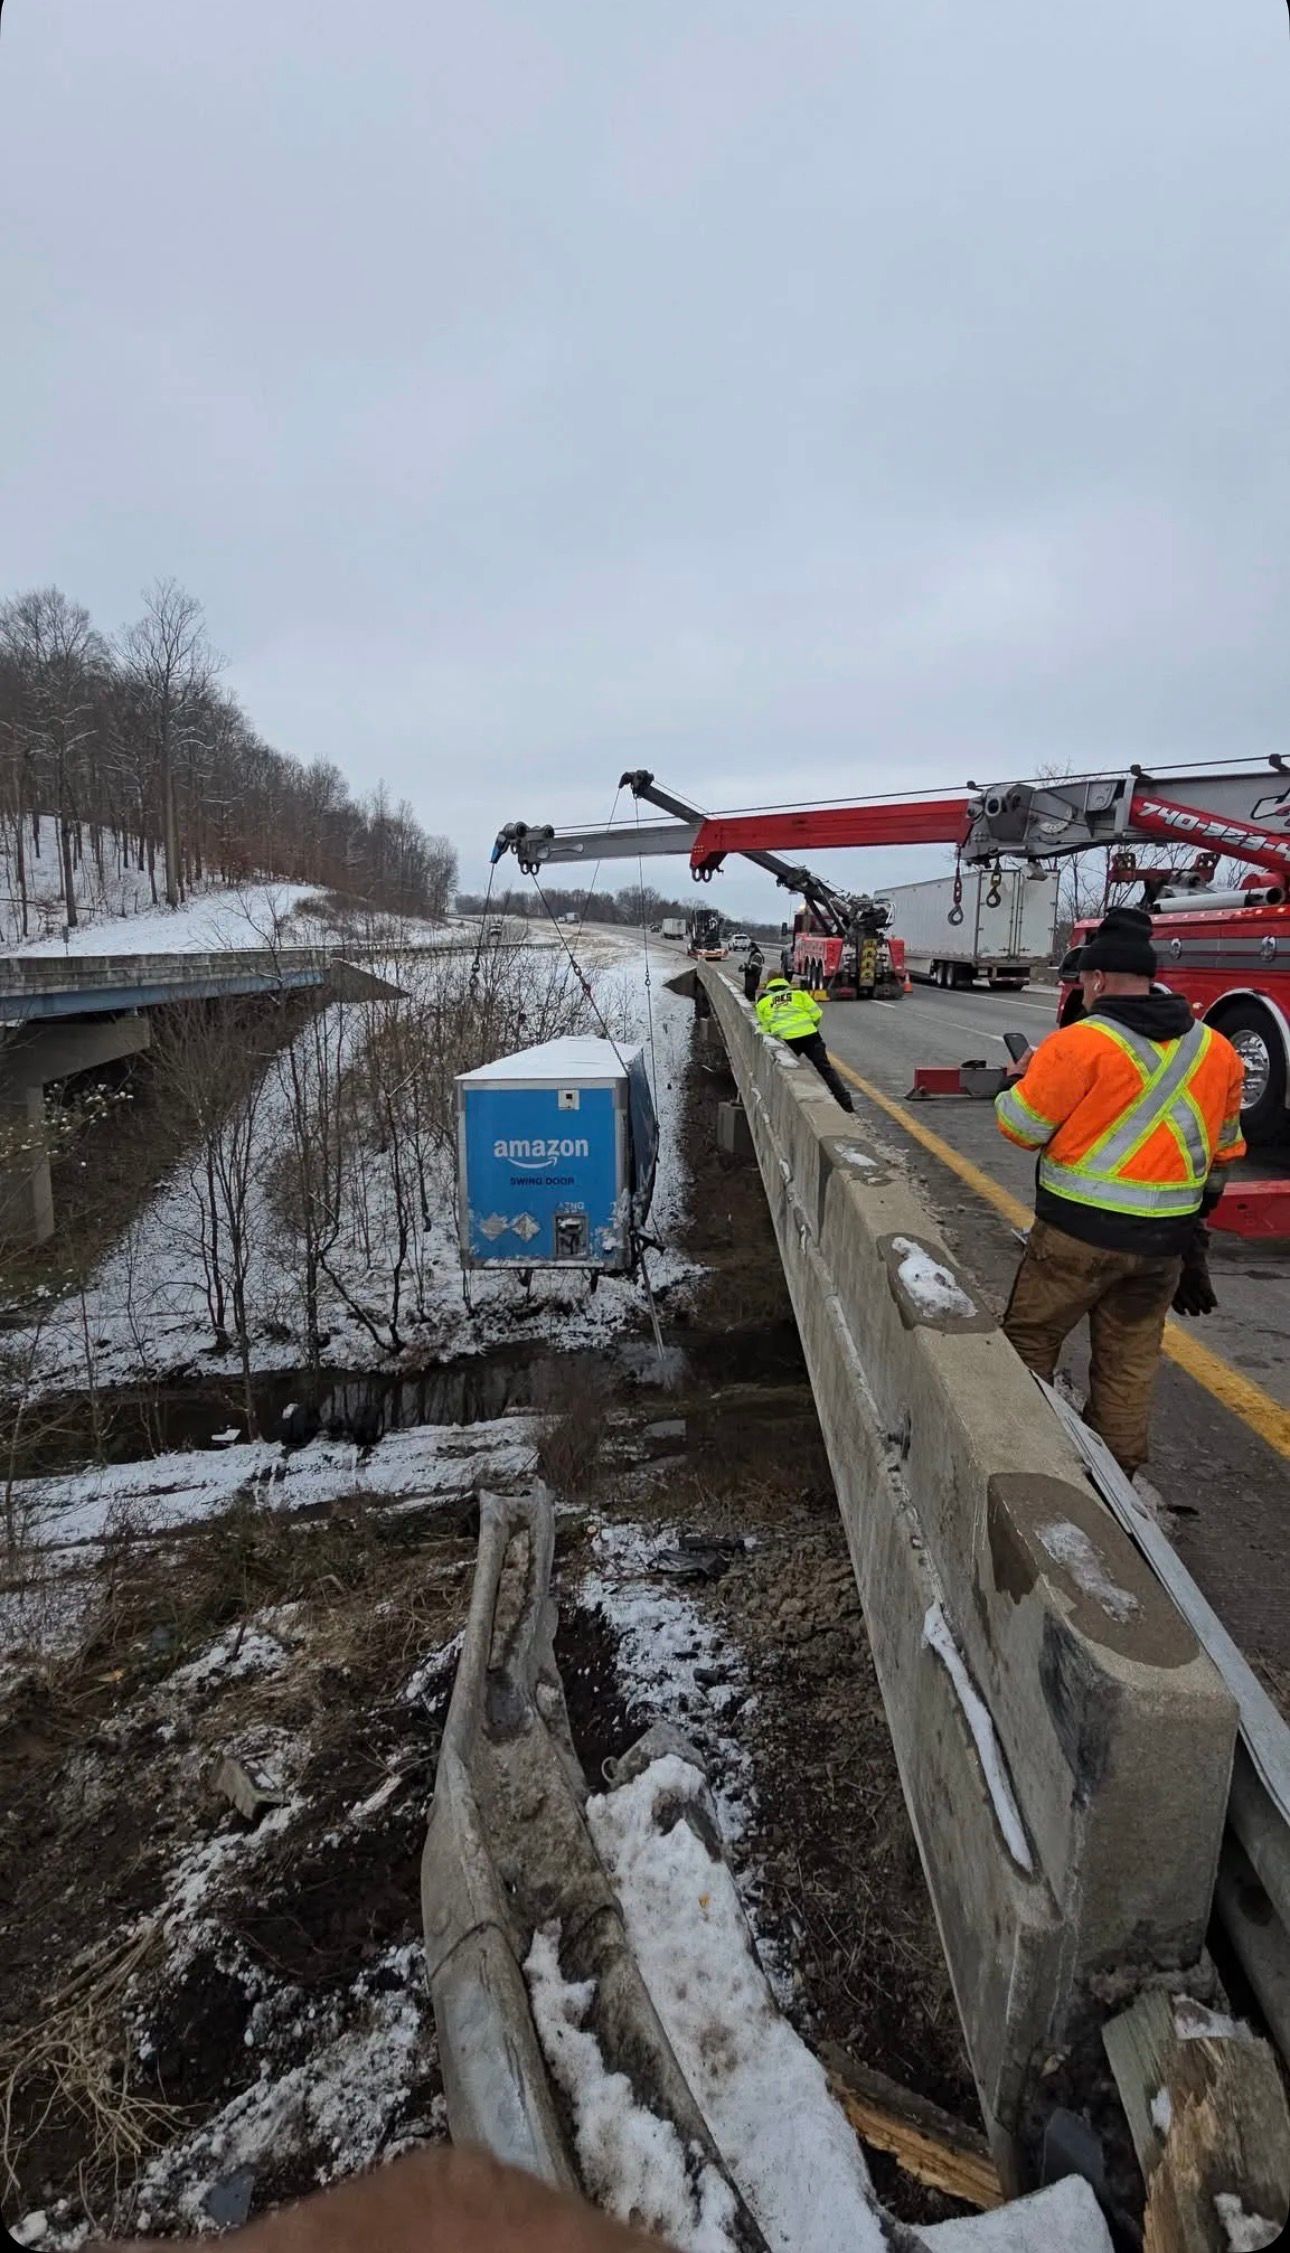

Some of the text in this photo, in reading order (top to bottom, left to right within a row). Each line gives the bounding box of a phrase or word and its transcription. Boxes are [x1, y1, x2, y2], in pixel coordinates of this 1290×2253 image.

[494, 1139, 589, 1157] amazon
[510, 1177, 575, 1185] SWING DOOR
